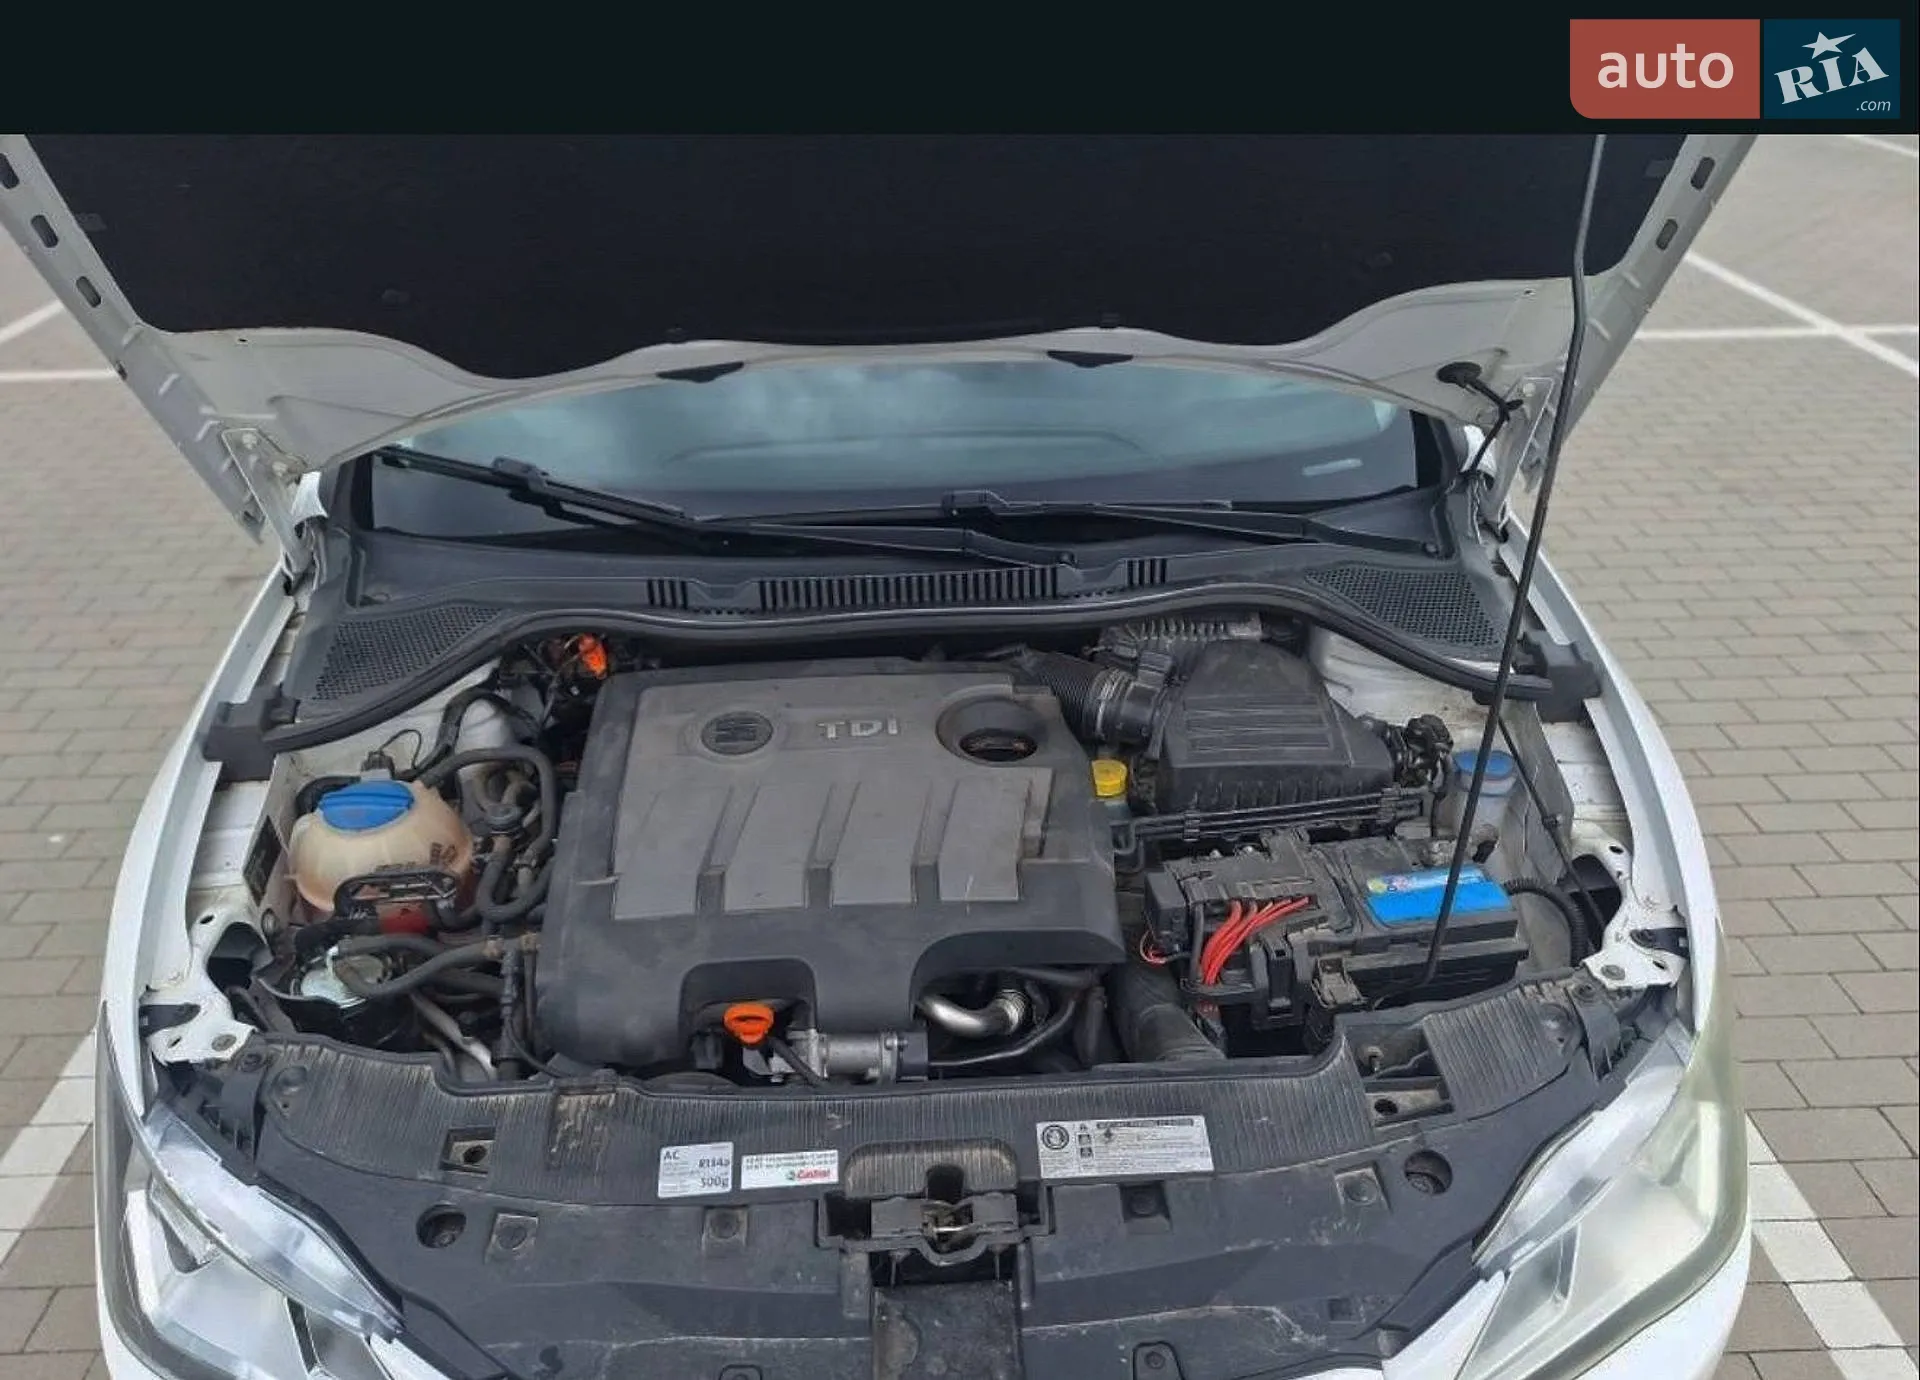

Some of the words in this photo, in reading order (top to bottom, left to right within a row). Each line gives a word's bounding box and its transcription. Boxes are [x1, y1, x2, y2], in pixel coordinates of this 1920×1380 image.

[818, 717, 900, 739] TDI
[663, 1150, 680, 1160] AC
[700, 1176, 730, 1188] 500g
